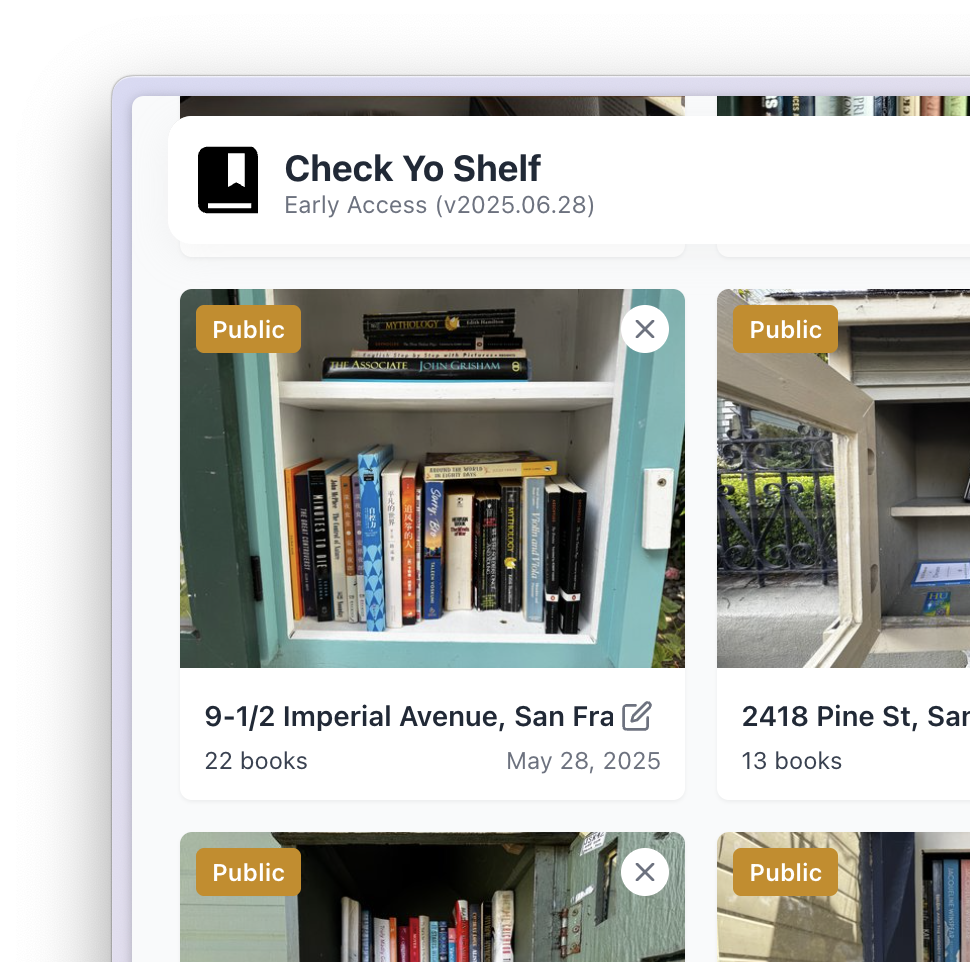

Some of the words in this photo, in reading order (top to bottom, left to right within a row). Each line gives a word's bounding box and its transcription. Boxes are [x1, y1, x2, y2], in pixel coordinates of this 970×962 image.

[286, 154, 394, 182] Check
[403, 155, 444, 182] Yo
[454, 154, 541, 182] Shelf
[286, 195, 339, 218] Early
[347, 196, 427, 214] Access
[437, 195, 593, 218] (v2025.06.28)
[214, 319, 284, 339] Public
[751, 319, 821, 339] Public
[330, 360, 350, 370] THE
[352, 359, 408, 371] ASSOCIATE
[419, 359, 448, 372] JOHN
[450, 359, 501, 371] GRISHAM
[427, 488, 442, 516] Sorry,
[313, 494, 325, 533] MINUTES
[428, 518, 442, 538] Bro
[506, 507, 515, 553] MYTHOLOGY
[530, 512, 541, 538] Violin
[315, 538, 325, 549] TO
[530, 539, 540, 557] and
[316, 554, 327, 568] DIE
[530, 557, 541, 579] Viola
[205, 705, 274, 731] 9-1/2
[285, 704, 390, 731] Imperial
[399, 706, 504, 732] Avenue,
[515, 705, 564, 727] San
[574, 706, 613, 727] Fra
[743, 705, 808, 727] 2418
[818, 704, 874, 727] Pine
[883, 705, 917, 732] St,
[205, 751, 232, 769] 22
[241, 751, 307, 770] books
[508, 752, 552, 774] May
[561, 751, 593, 774] 28,
[604, 751, 660, 770] 2025
[742, 751, 766, 770] 13
[776, 751, 842, 770] books
[214, 862, 284, 882] Public
[751, 862, 821, 882] Public
